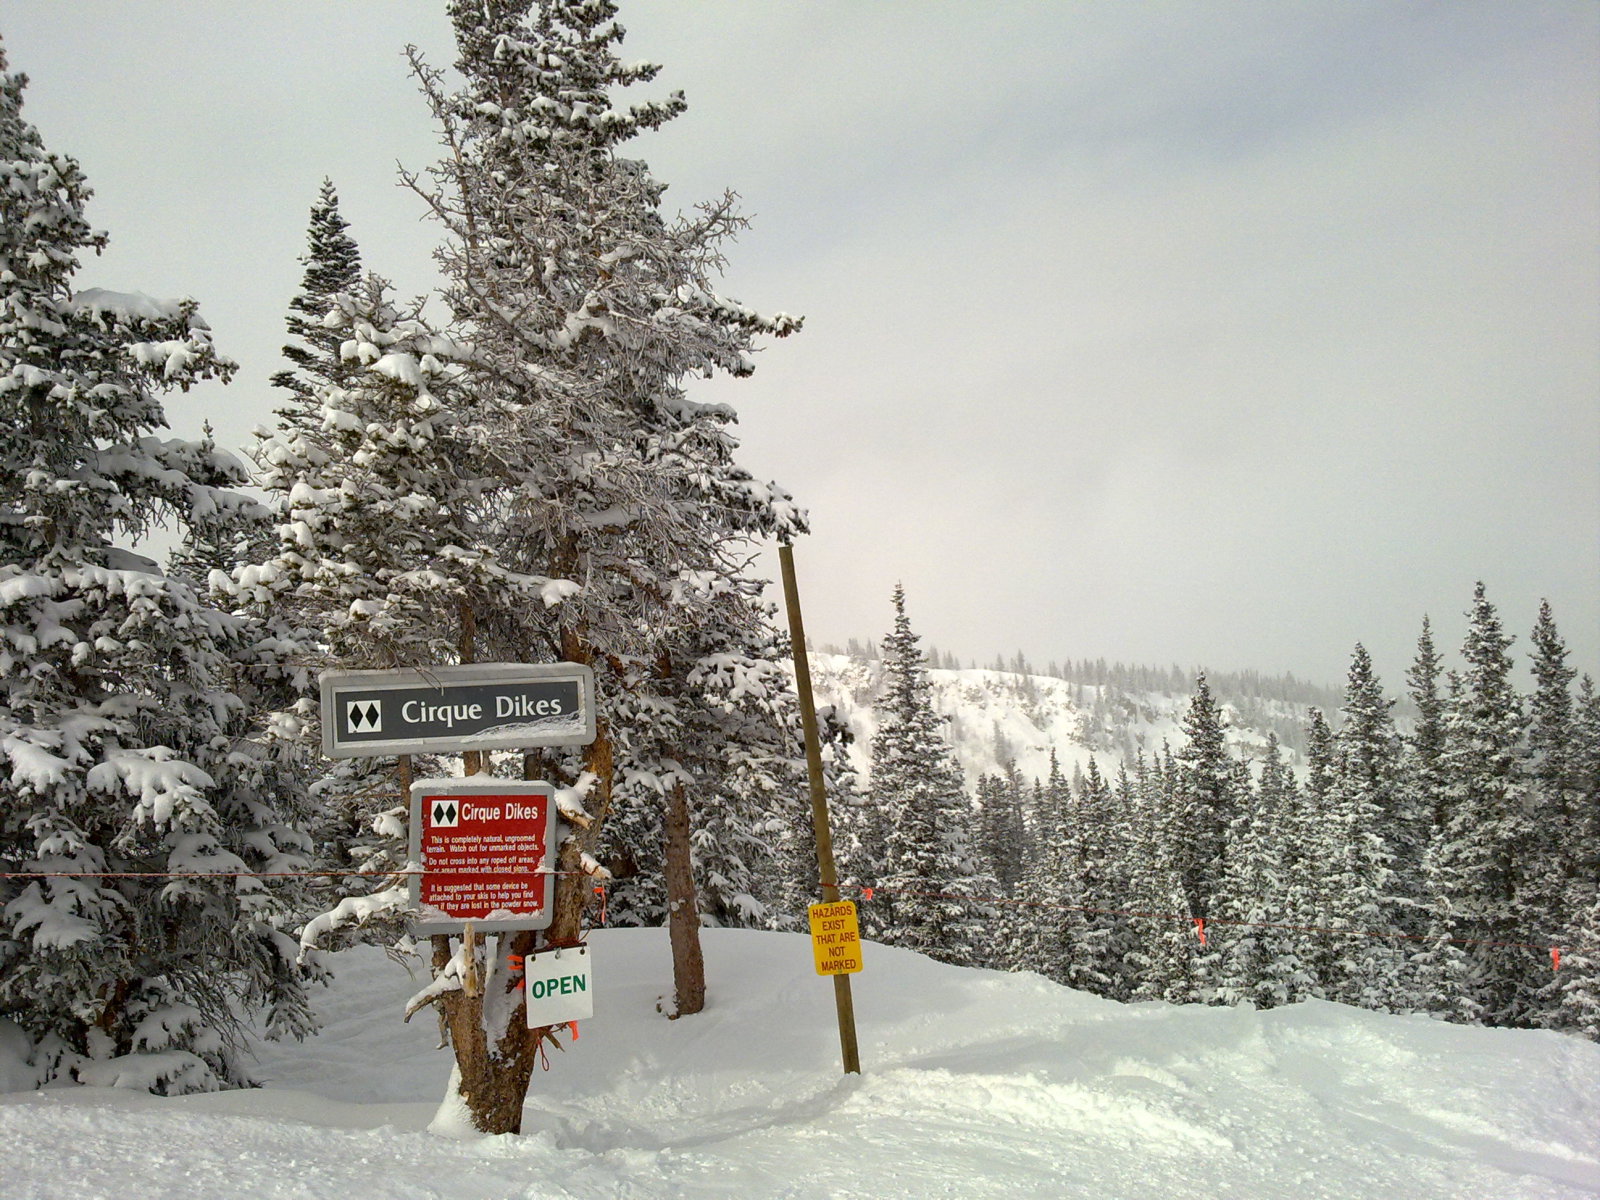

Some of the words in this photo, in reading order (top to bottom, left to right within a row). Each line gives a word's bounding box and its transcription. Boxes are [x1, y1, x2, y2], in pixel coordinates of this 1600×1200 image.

[402, 700, 482, 728] Cirque
[496, 695, 562, 718] Dikes
[462, 803, 500, 824] Cirque
[505, 802, 538, 820] Dikes
[451, 835, 482, 845] completely
[505, 834, 535, 843] ungroomed
[517, 844, 539, 852] objects.
[479, 858, 489, 866] any
[491, 856, 507, 866] roped
[444, 883, 472, 892] suggested
[463, 894, 476, 902] your
[498, 892, 509, 900] help
[446, 903, 458, 911] they
[501, 900, 521, 909] powder
[812, 906, 852, 919] HAZARDS
[822, 920, 845, 931] EXIST
[816, 934, 836, 945] THAT
[839, 932, 856, 942] ARE
[829, 947, 845, 957] NOT
[821, 959, 856, 971] MARKED
[532, 974, 586, 999] OPEN
